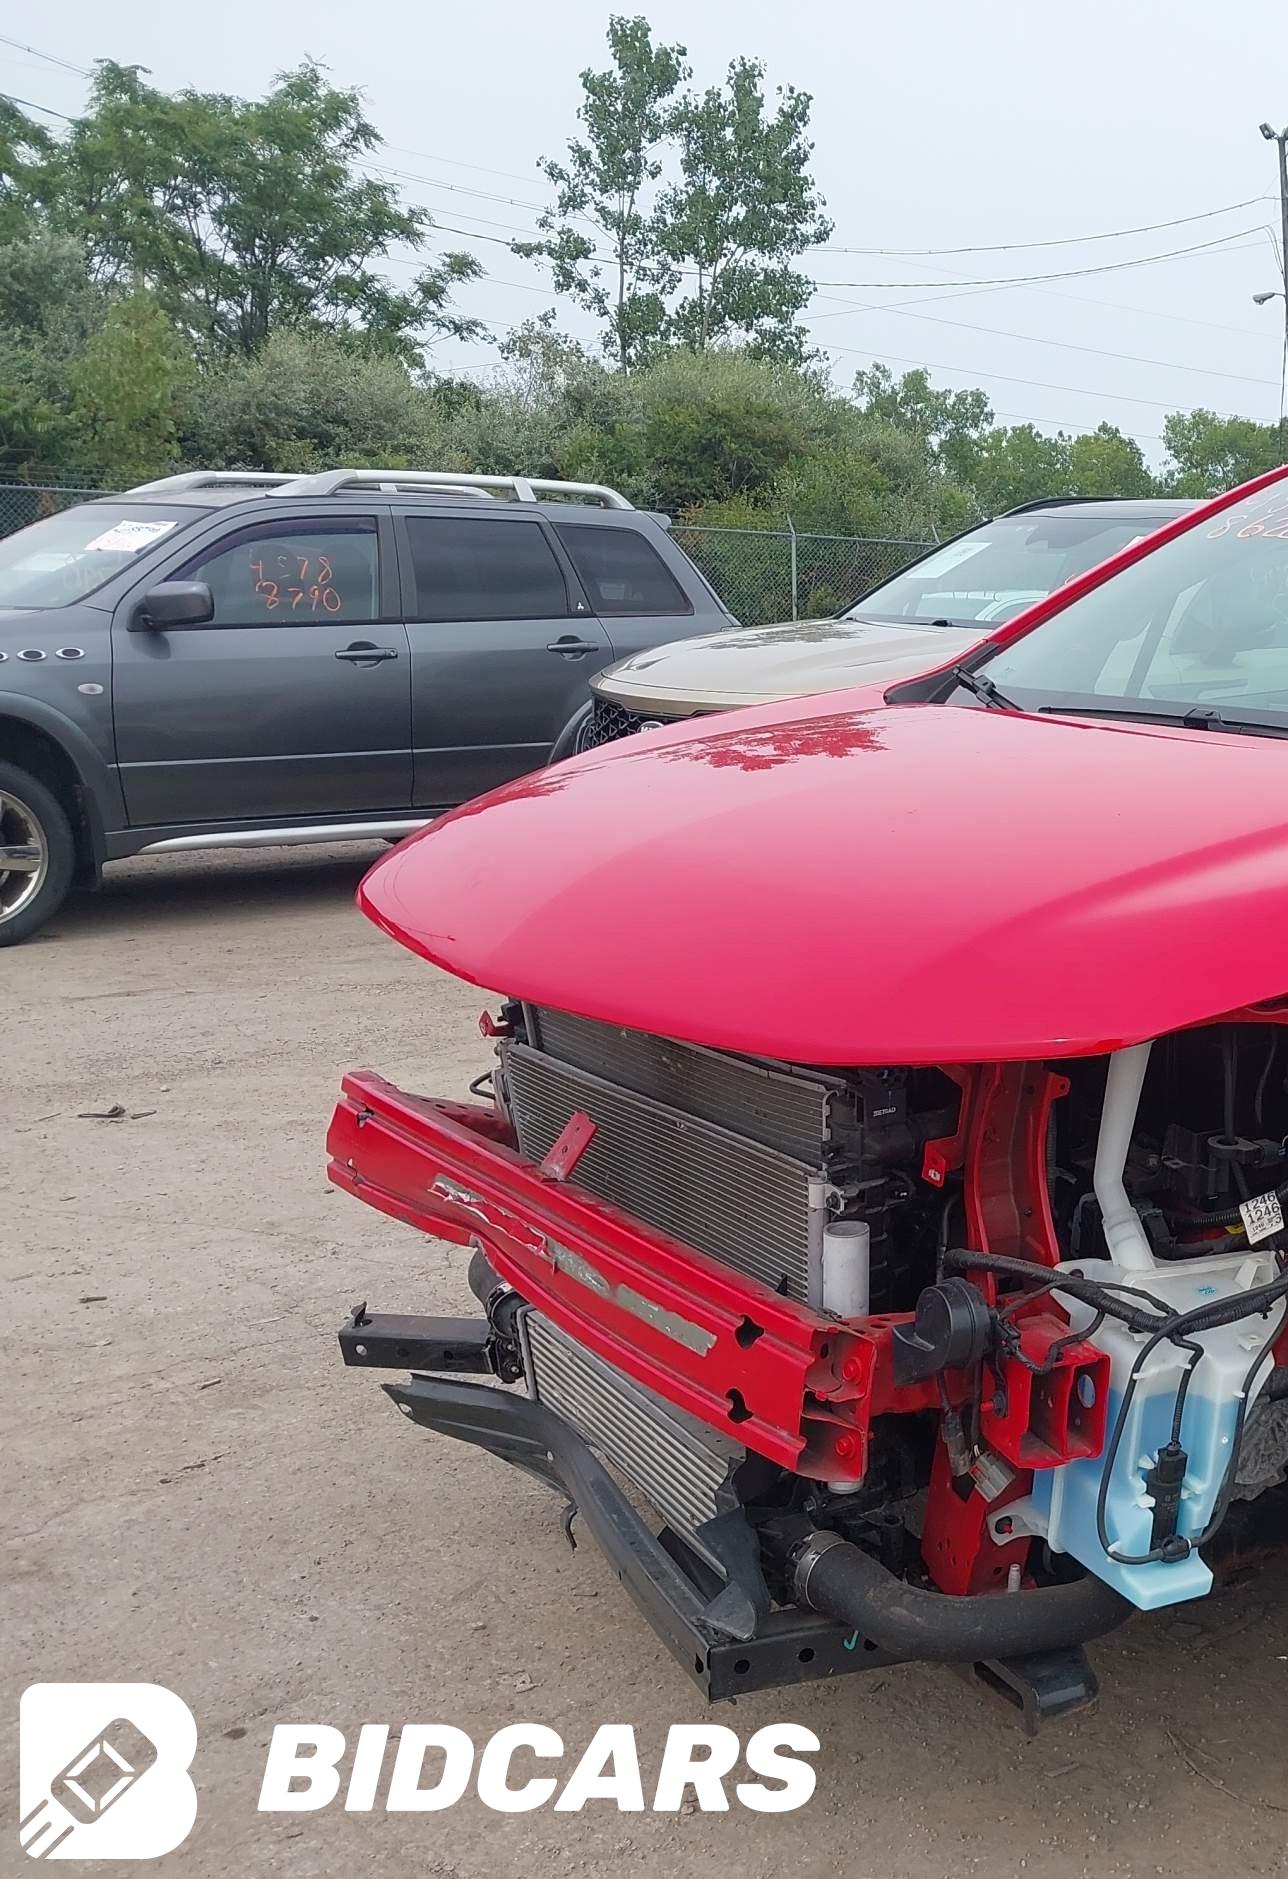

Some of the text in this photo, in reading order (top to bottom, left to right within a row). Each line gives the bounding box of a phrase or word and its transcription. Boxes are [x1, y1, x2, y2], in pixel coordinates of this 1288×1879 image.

[255, 580, 342, 612] 8790
[1244, 1190, 1276, 1213] 1246
[1247, 1202, 1280, 1225] 1246
